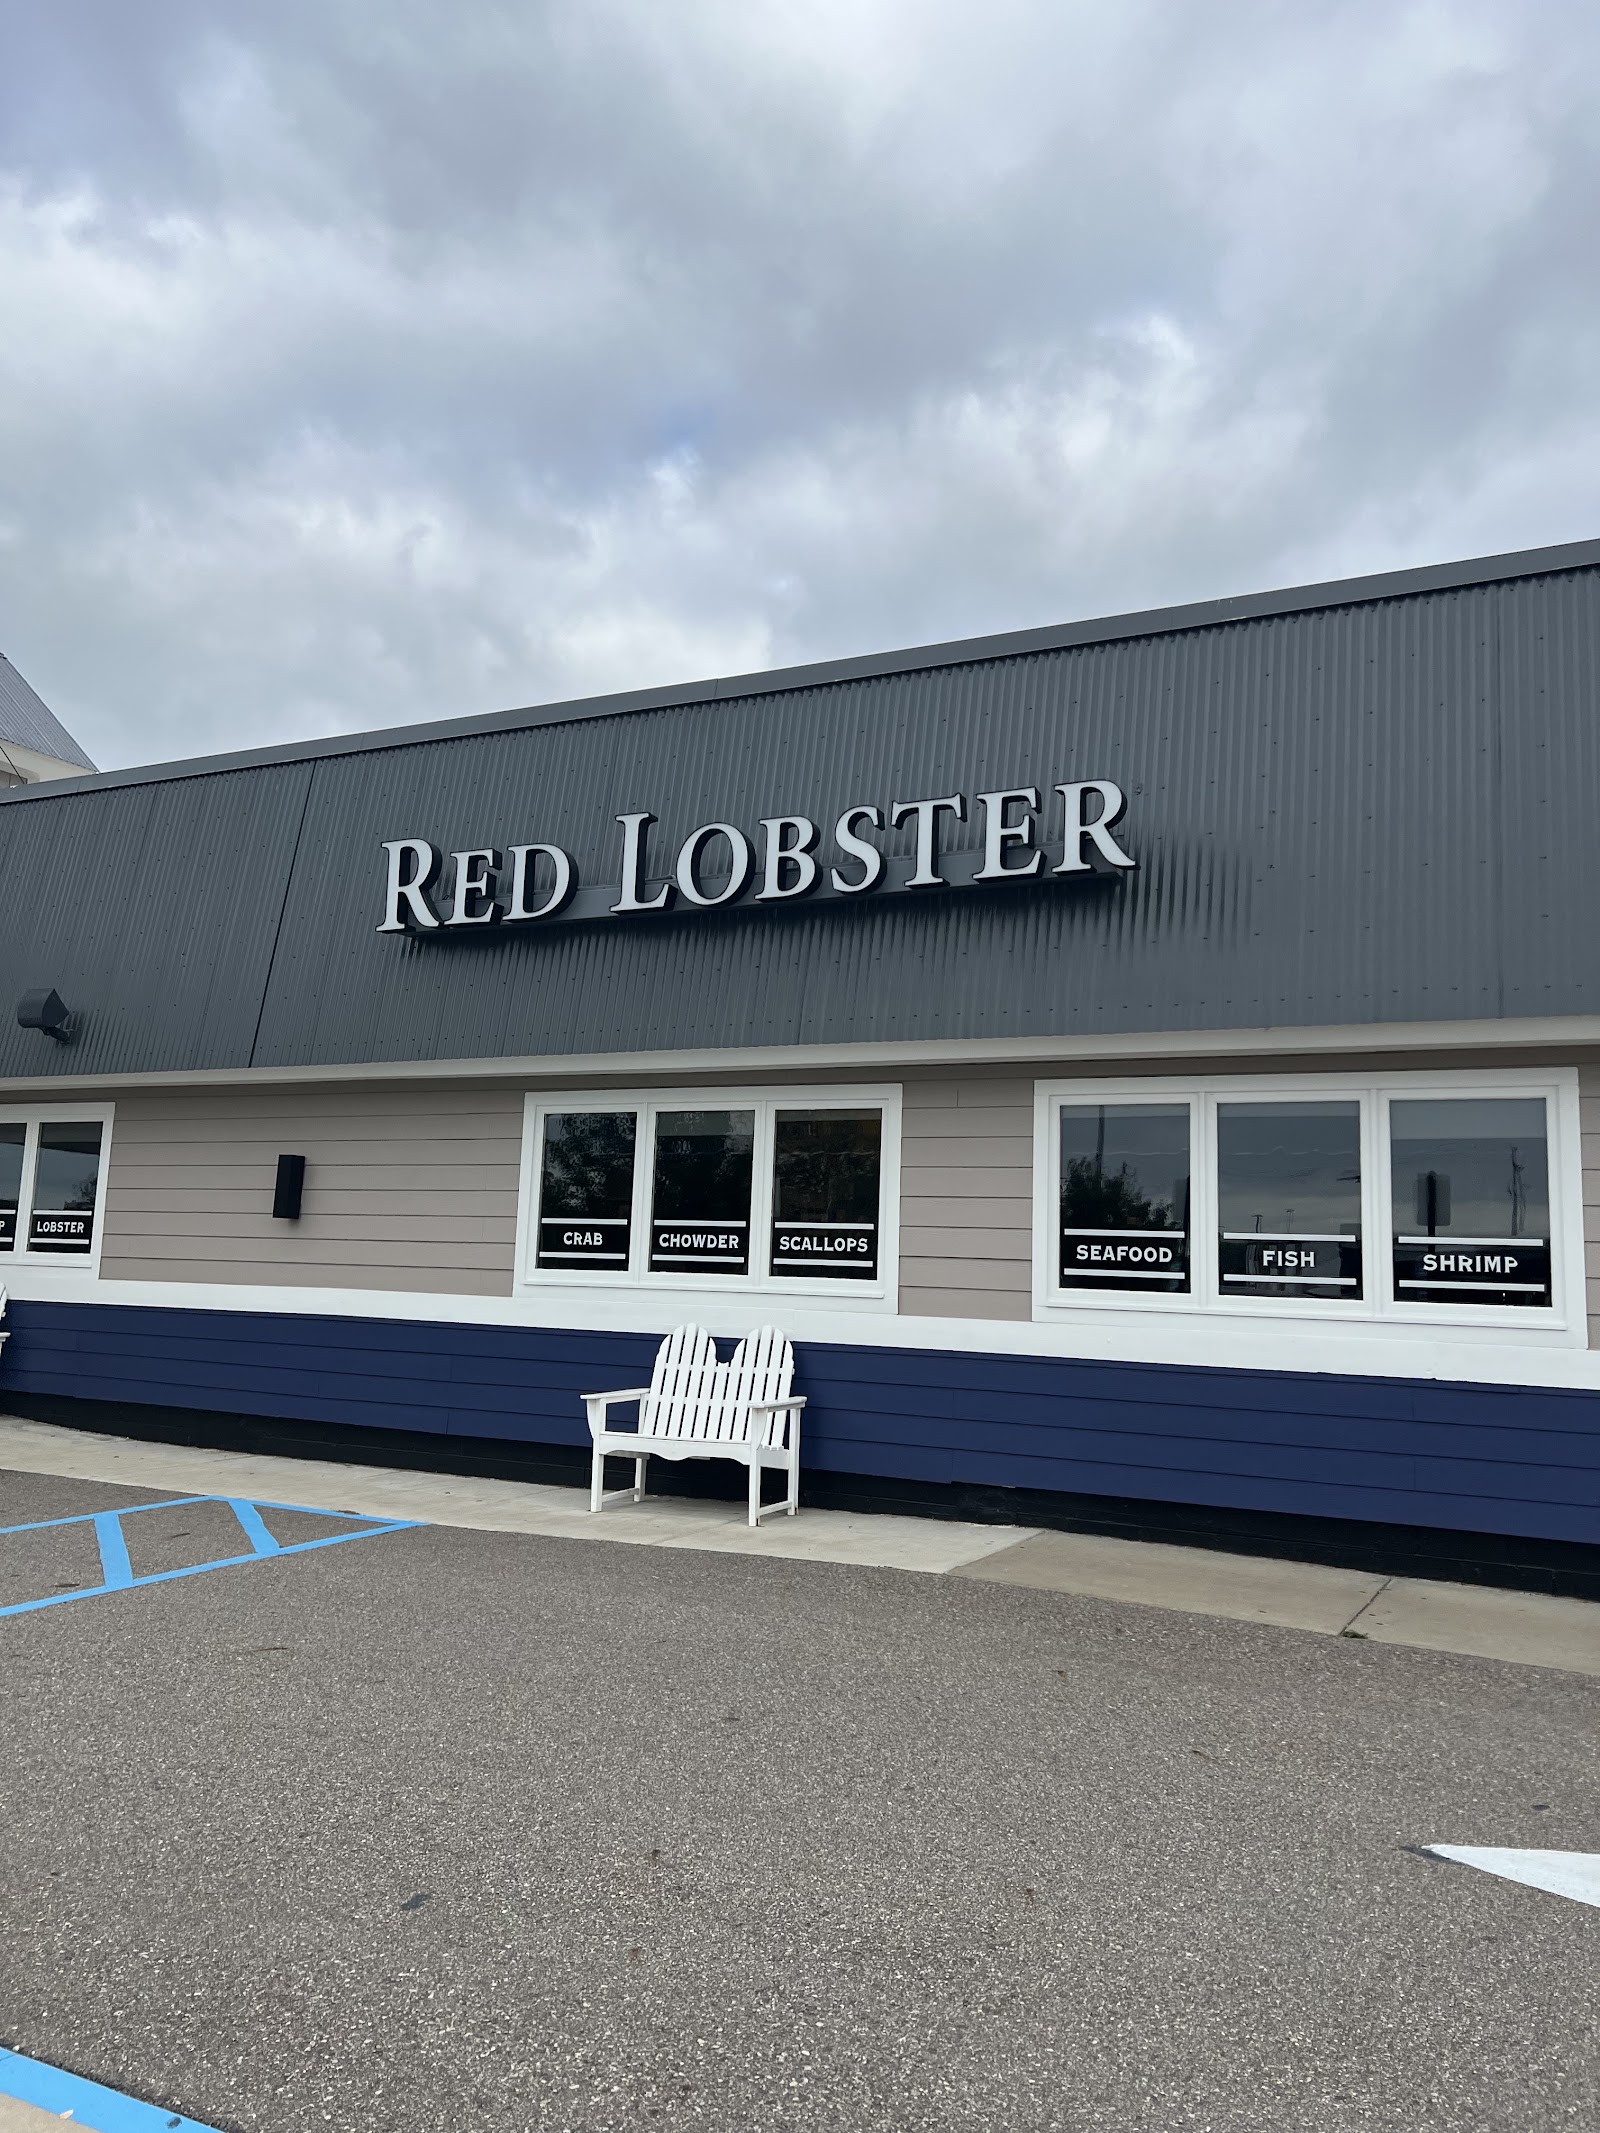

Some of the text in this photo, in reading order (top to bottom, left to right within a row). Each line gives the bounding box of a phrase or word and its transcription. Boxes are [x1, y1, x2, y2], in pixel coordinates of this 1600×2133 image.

[376, 779, 1137, 932] RED LOBSTER
[36, 1220, 85, 1233] LOBSTER
[563, 1231, 603, 1246] CRAB
[659, 1233, 739, 1249] CHOWDER
[779, 1236, 868, 1253] SCALLOPS
[1076, 1244, 1173, 1263] SEAFOOD
[1262, 1250, 1315, 1268] FISH
[1423, 1254, 1518, 1274] SHRIMP
